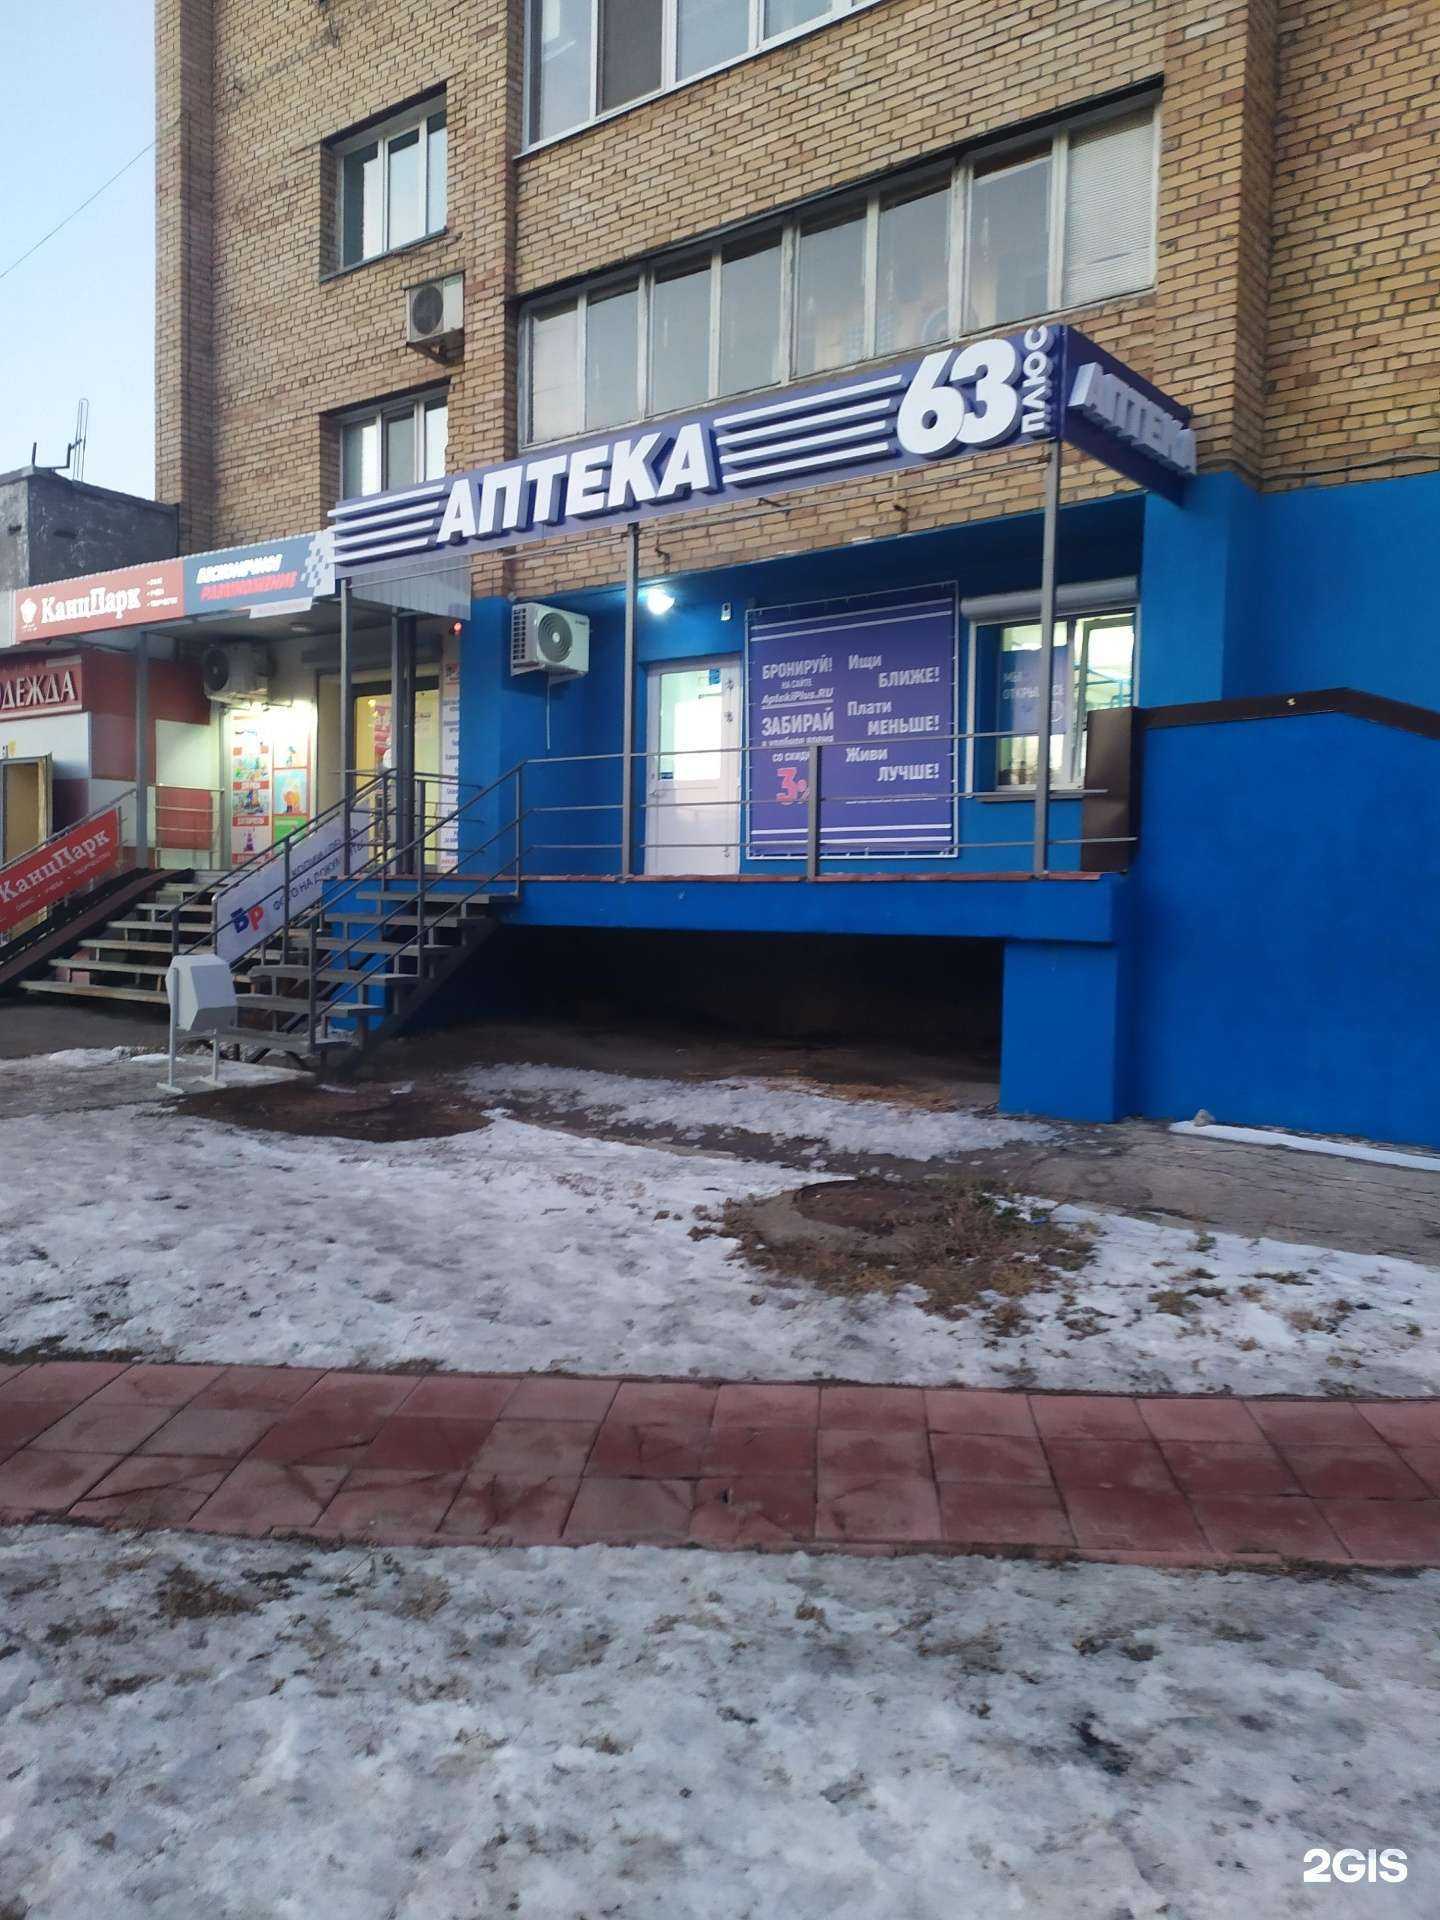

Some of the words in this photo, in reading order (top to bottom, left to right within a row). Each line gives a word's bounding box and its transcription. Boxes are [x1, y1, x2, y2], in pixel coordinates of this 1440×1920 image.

[436, 422, 710, 544] АПТЕКА
[897, 338, 1019, 455] 63
[1020, 324, 1048, 435] ПЛЮС
[40, 586, 142, 624] КанцПарк
[762, 654, 833, 680] БРОНИРУЙ!
[848, 654, 882, 670] Ищи
[878, 666, 940, 688] БЛИЖЕ!
[0, 669, 76, 710] ДЕЖДА
[847, 701, 892, 716] Плати
[761, 706, 834, 736] ЗАБИРАЙ
[867, 715, 940, 736] МЕНЬШЕ!
[846, 747, 888, 762] Живи
[877, 763, 940, 782] ЛУЧШЕ!
[0, 830, 111, 904] КанцПарк
